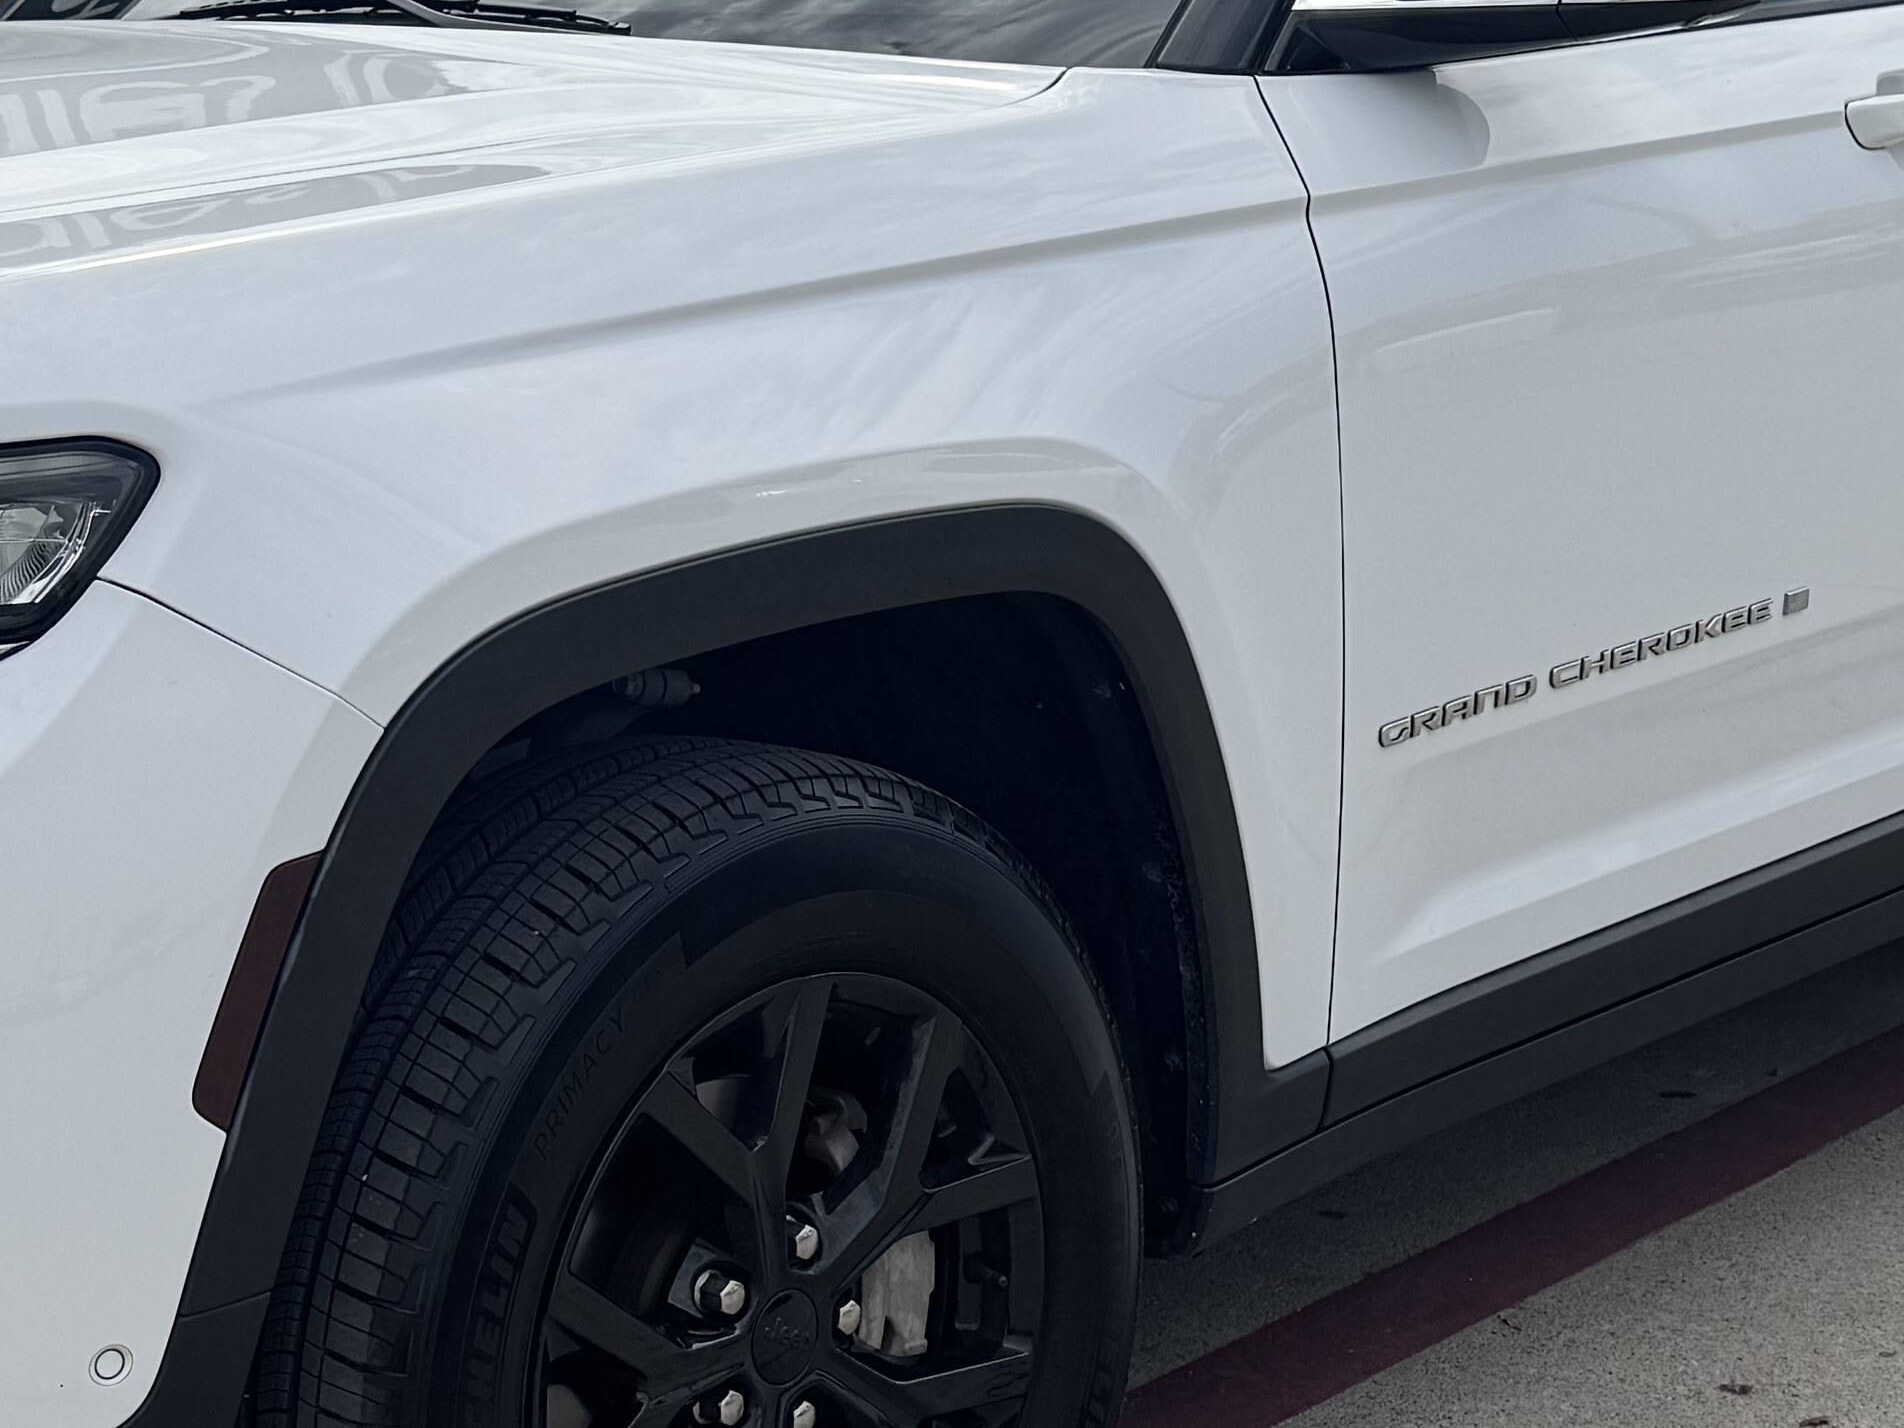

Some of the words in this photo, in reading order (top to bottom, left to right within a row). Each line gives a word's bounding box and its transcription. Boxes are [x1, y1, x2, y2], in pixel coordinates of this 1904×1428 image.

[1377, 673, 1538, 748] GRAND
[1548, 597, 1775, 690] CHEROKEE
[533, 1005, 624, 1161] PRIMACY
[763, 1316, 811, 1354] Jeep
